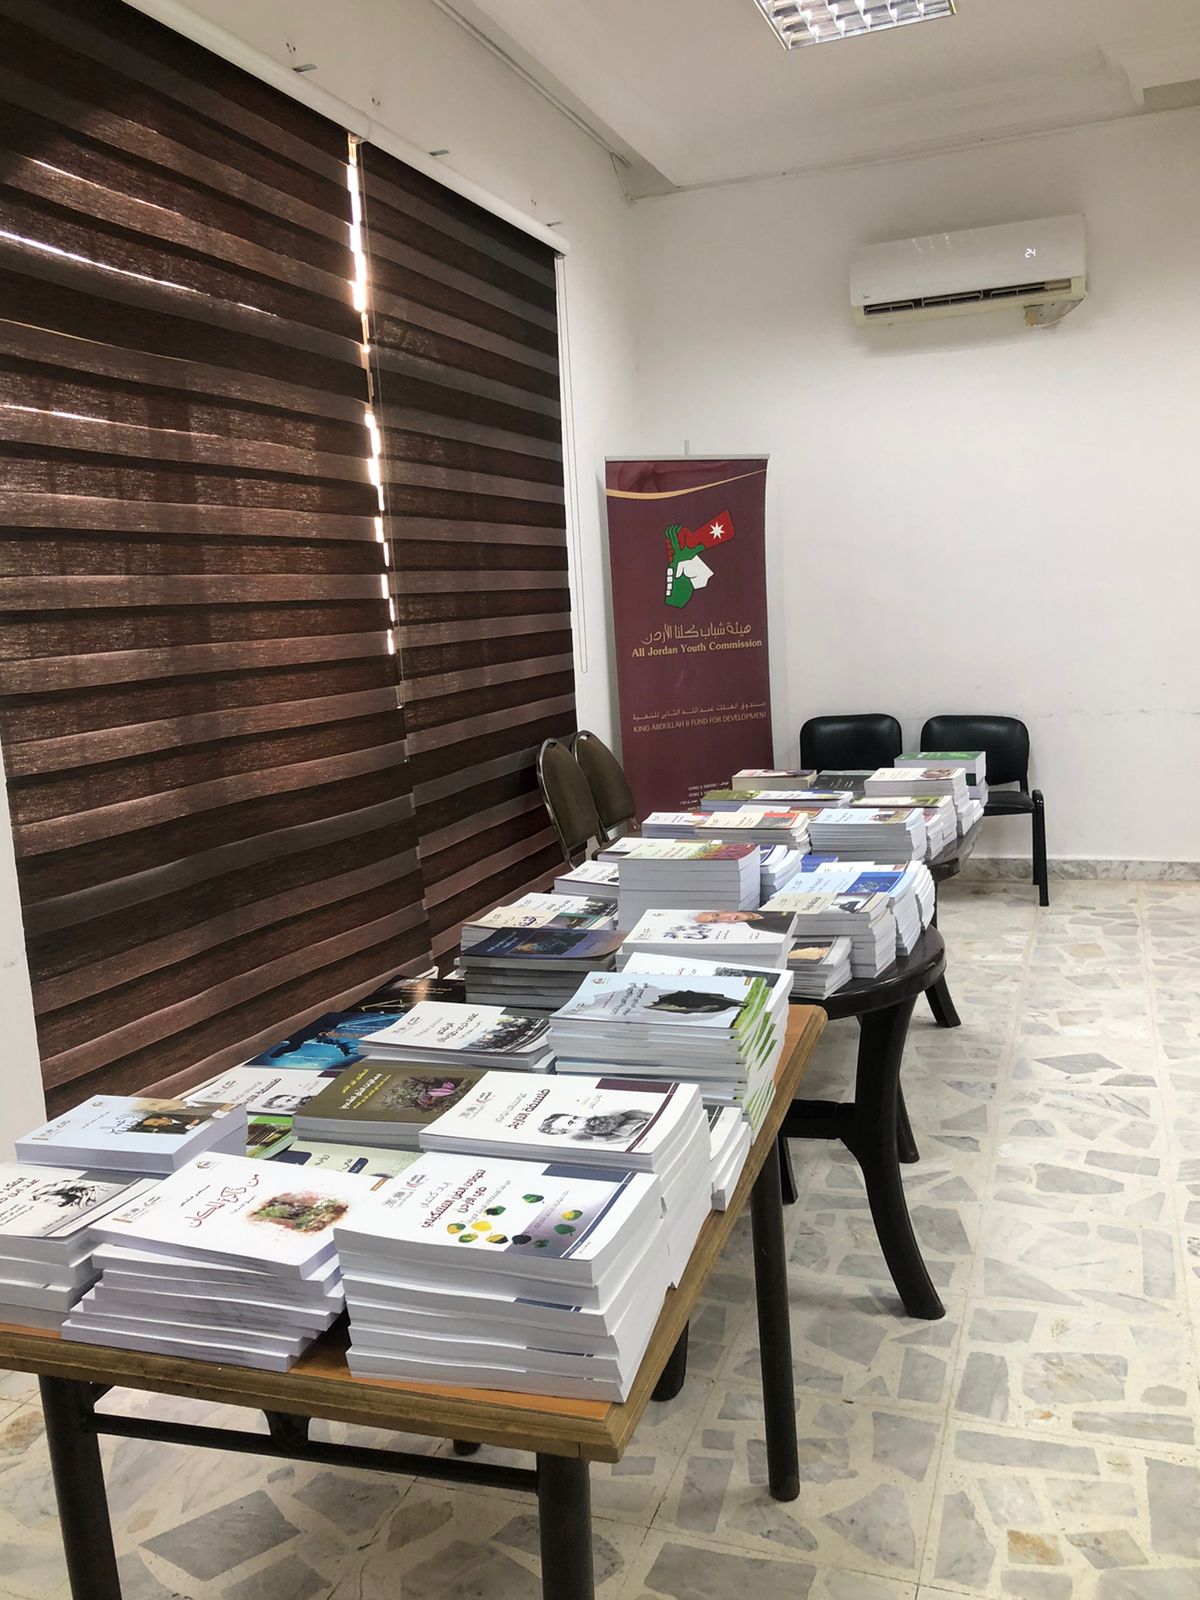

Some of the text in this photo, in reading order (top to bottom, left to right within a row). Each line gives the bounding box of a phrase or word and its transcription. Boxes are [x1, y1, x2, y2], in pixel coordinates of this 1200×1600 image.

[1024, 248, 1036, 258] 24
[640, 621, 752, 645] هيئة شباب كلنا الأردن
[632, 639, 762, 658] All Jordan Youth Commission
[634, 725, 650, 733] KING
[651, 720, 684, 731] ABDULLAH
[691, 718, 708, 727] FUND
[709, 716, 722, 724] FOR
[722, 711, 767, 723] DEVELOPMENT
[507, 1088, 550, 1130] فلسفة التاريخ
[246, 1174, 259, 1188] من
[452, 1186, 467, 1200] الفن
[457, 1186, 487, 1214] في الأردن
[184, 1200, 225, 1228] المكان
[420, 1199, 452, 1228] التشكيلي
